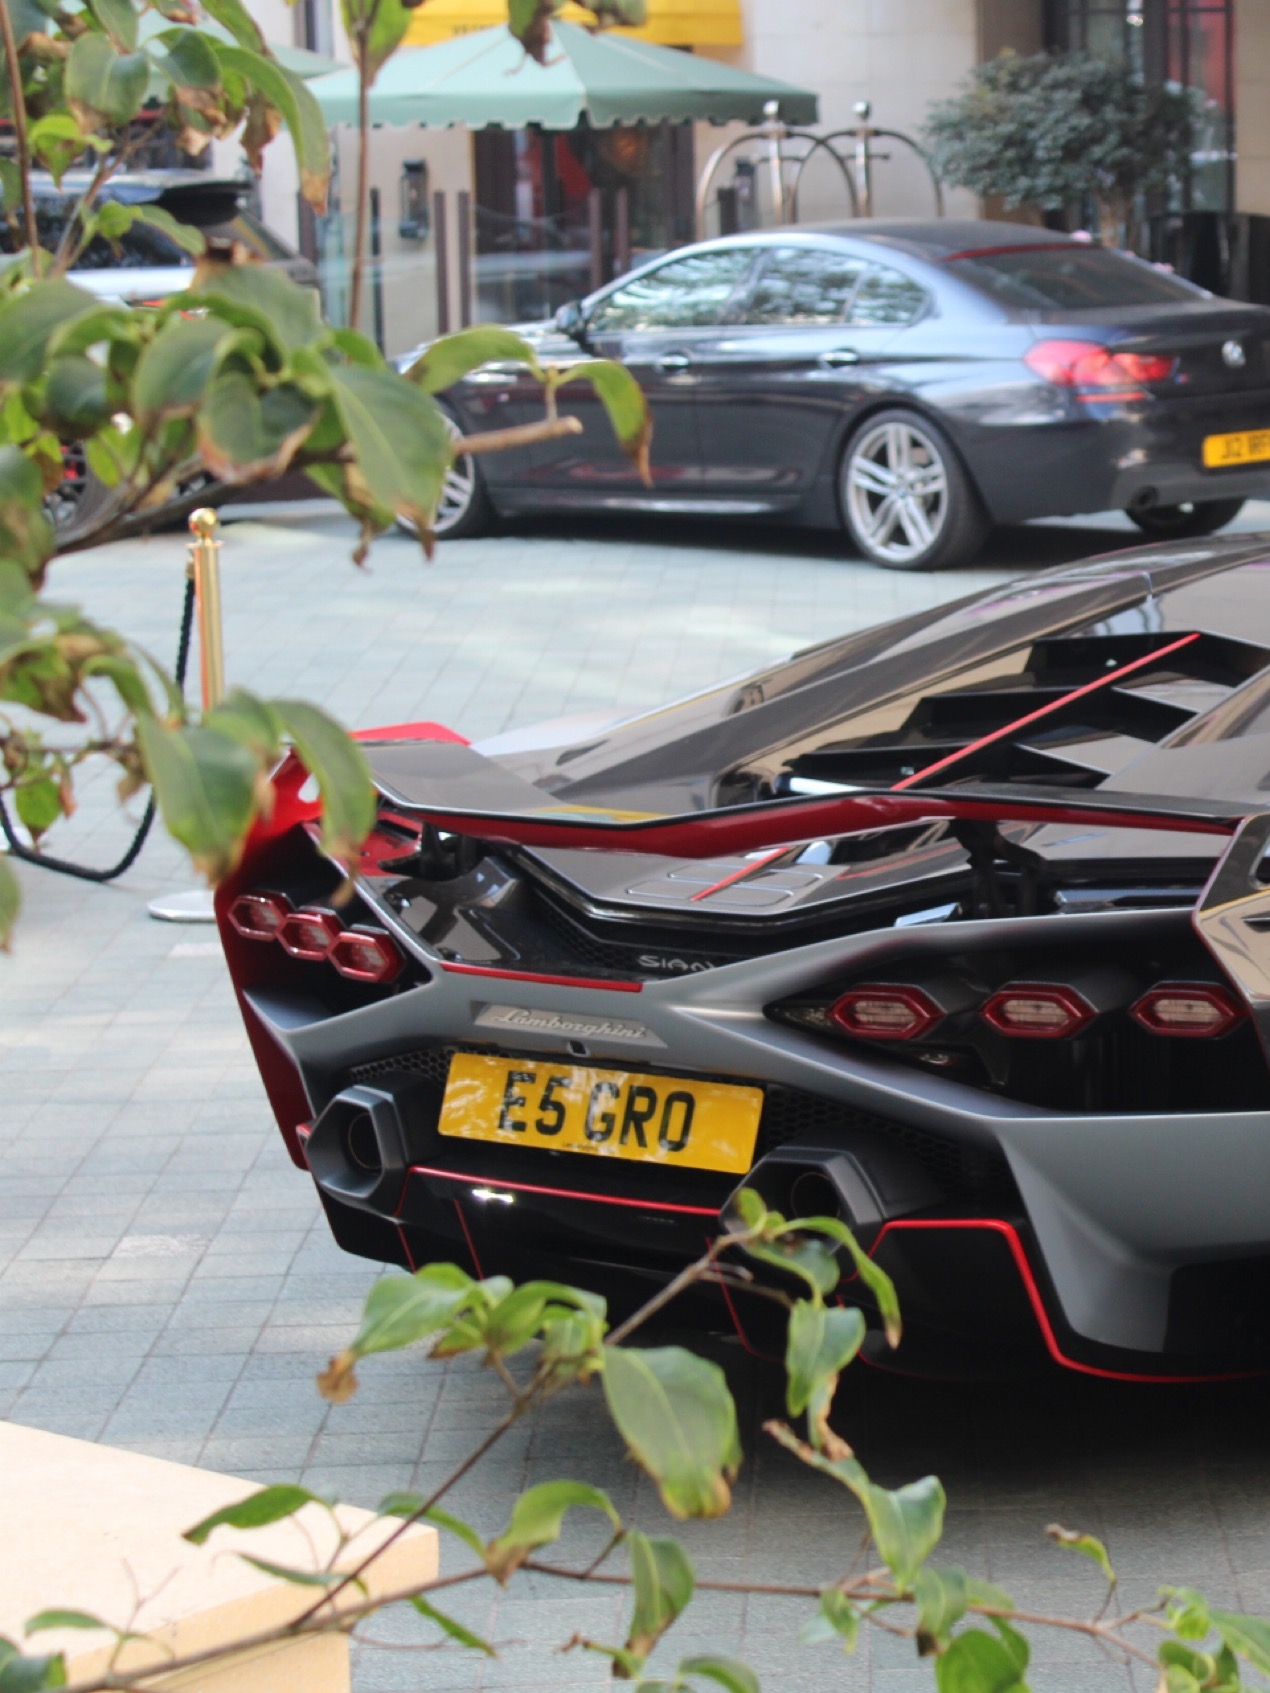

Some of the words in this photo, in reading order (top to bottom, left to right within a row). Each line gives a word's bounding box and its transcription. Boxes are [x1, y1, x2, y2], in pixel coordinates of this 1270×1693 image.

[493, 1008, 648, 1038] Lamborghini
[497, 1070, 572, 1136] E5
[584, 1081, 696, 1152] GRO
